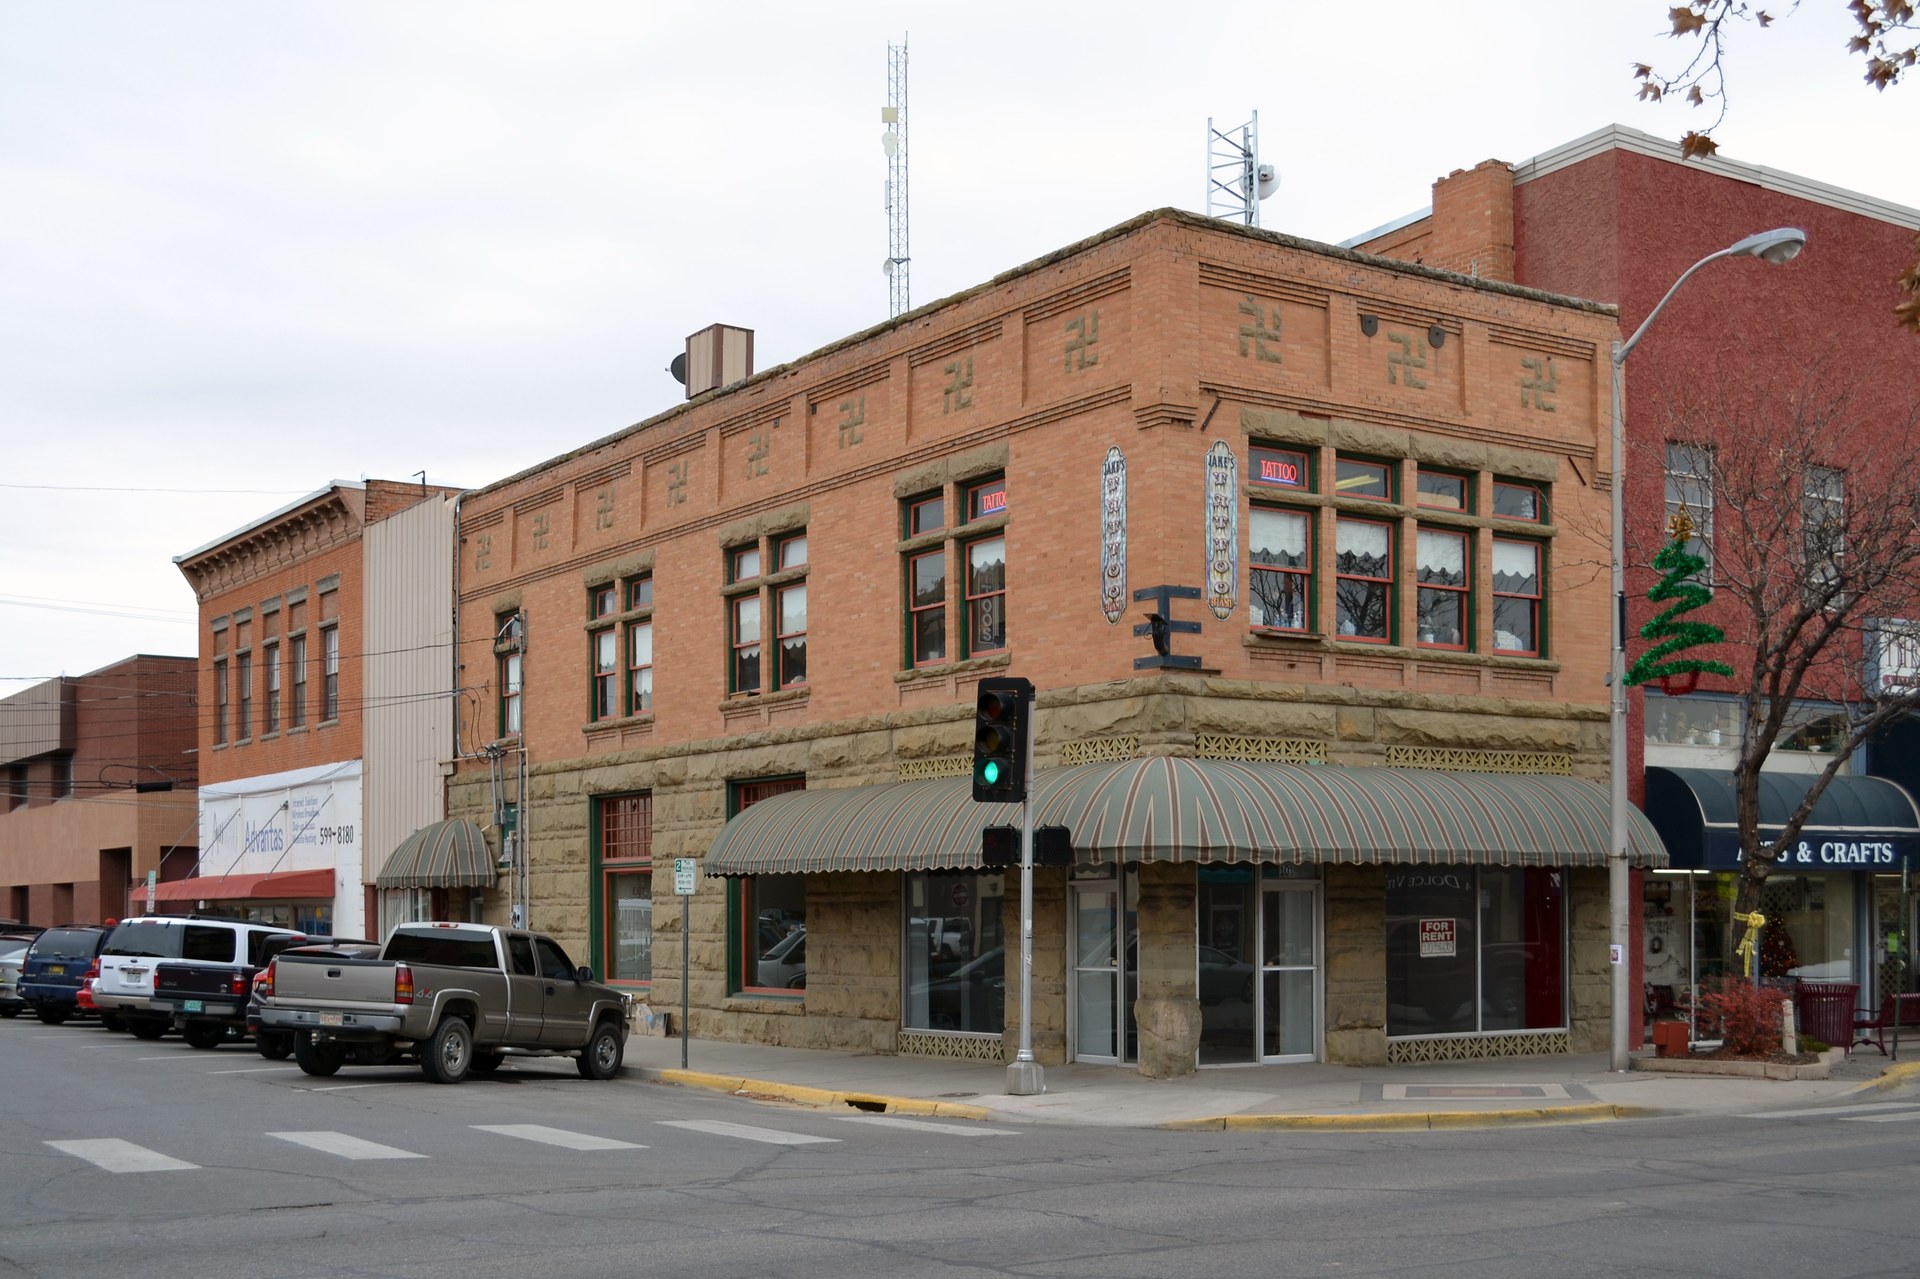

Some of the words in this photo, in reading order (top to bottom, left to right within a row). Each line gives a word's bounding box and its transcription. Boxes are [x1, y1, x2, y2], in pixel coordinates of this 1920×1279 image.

[1103, 459, 1125, 476] JAKE'S
[1208, 455, 1235, 470] JAKE'S
[1261, 459, 1297, 481] TATTOO
[245, 819, 284, 853] Advantas
[320, 825, 354, 846] 599-8180
[1797, 841, 1812, 863] &
[1820, 842, 1893, 863] CRAFTS
[1422, 931, 1452, 942] RENT
[1426, 922, 1449, 932] FOR
